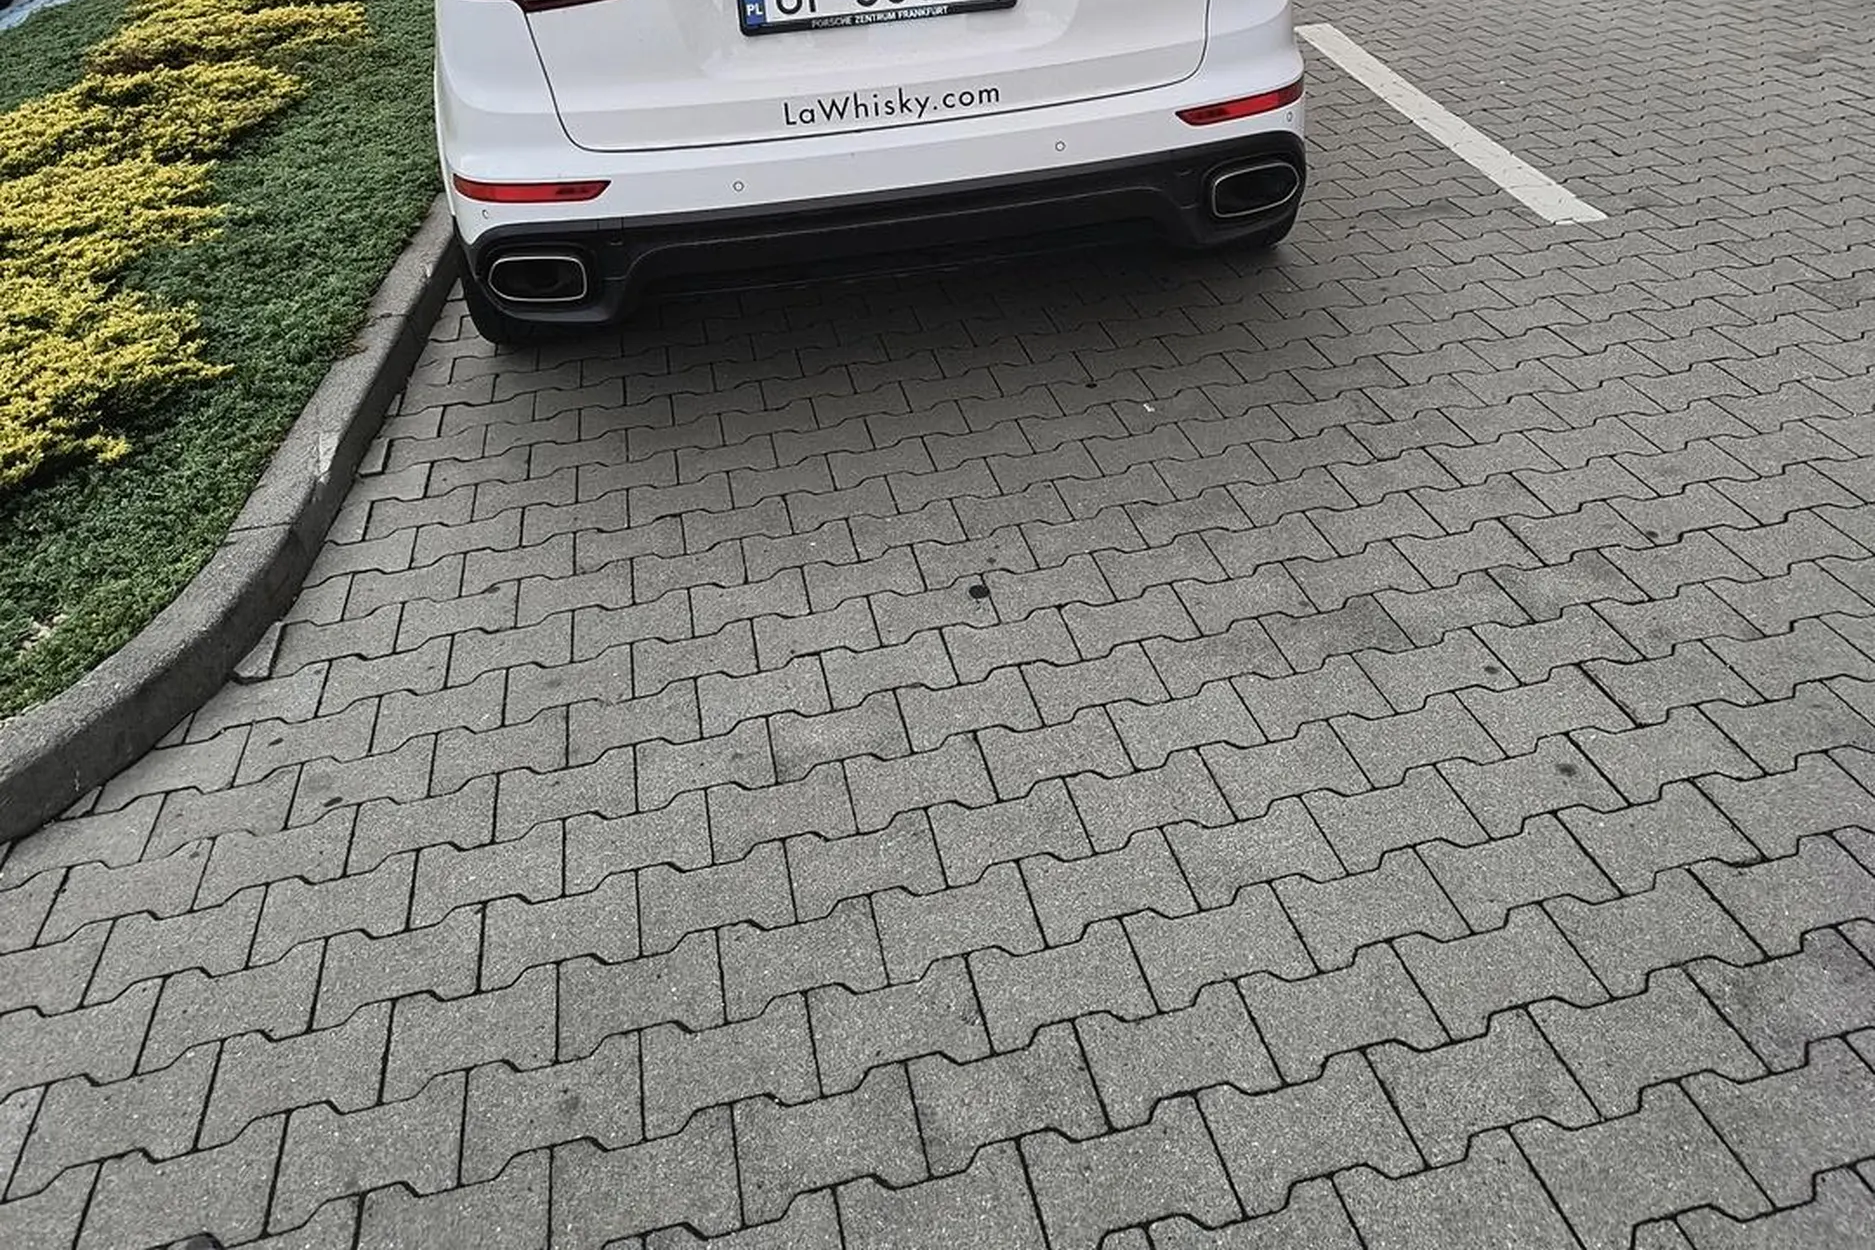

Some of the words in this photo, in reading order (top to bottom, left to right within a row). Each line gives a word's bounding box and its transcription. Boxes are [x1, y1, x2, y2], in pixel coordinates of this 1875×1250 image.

[746, 4, 763, 16] PL
[811, 15, 853, 29] PORSCHE
[855, 10, 897, 25] ZENTRUM
[898, 5, 949, 20] FRANKFURT
[783, 87, 1001, 126] LaWhisky.com
